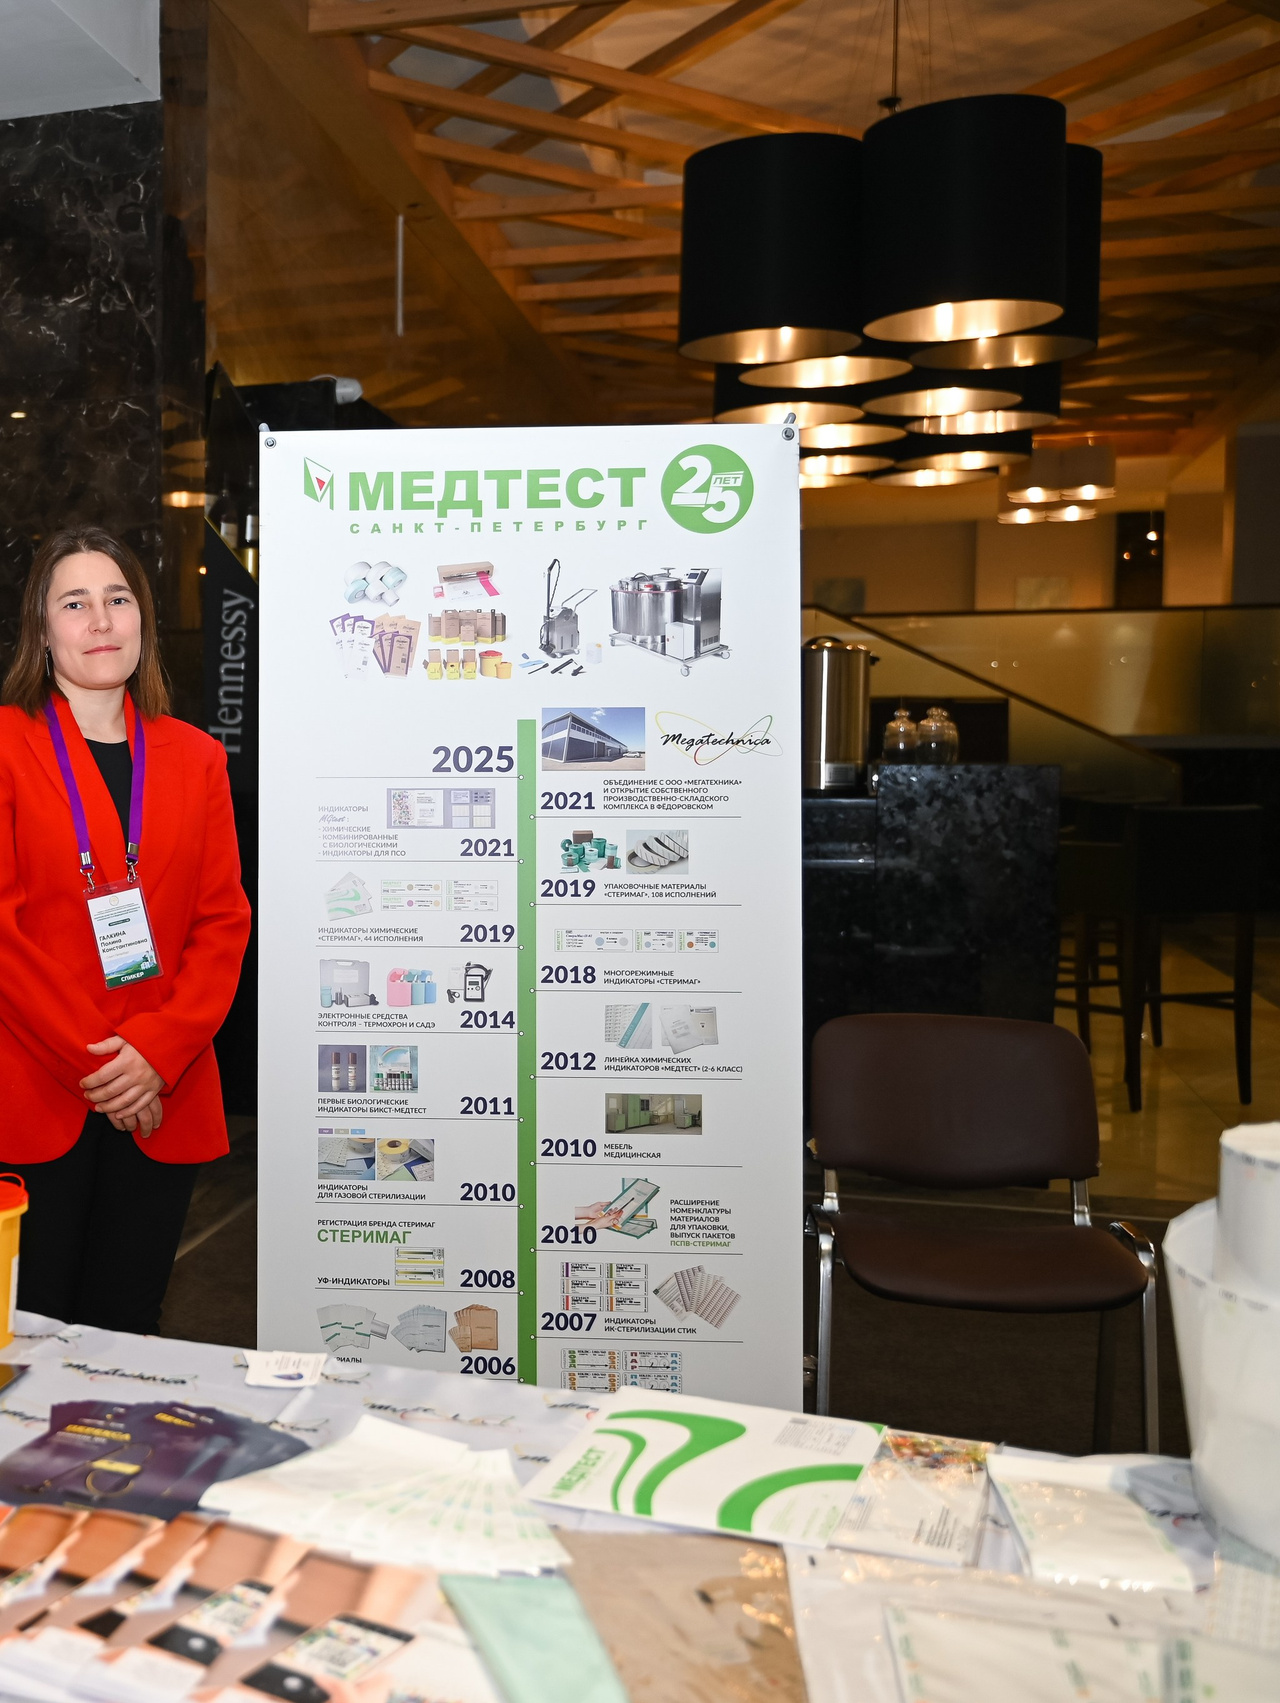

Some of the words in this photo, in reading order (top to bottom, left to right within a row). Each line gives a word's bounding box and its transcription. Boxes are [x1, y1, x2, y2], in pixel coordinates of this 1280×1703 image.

[713, 476, 741, 485] ЛЕТ
[348, 467, 646, 519] МЕДТЕСТ
[670, 454, 740, 524] 25
[349, 519, 649, 534] САНКТ-ПЕТЕРБУРГ
[208, 588, 254, 753] Hennessy
[660, 732, 771, 752] Megatechnica
[432, 745, 515, 773] 2025
[540, 791, 595, 810] 2021
[656, 802, 714, 811] ФЁДОРОВСКОМ
[460, 838, 515, 857] 2021
[322, 850, 373, 858] ИНДИКАТОРЫ
[373, 850, 390, 858] ДЛЯ
[540, 879, 596, 898] 2019
[604, 891, 650, 899] «СТЕРИМАГ»,
[664, 890, 717, 898] ИСПОЛНЕНИЙ
[99, 930, 126, 942] ГАЛКИНА
[318, 927, 368, 935] ИНДИКАТОРЫ
[460, 924, 515, 943] 2019
[120, 972, 145, 982] СПИКЕР
[540, 965, 596, 984] 2018
[603, 978, 655, 986] ИНДИКАТОРЫ
[318, 1012, 371, 1020] ЭЛЕКТРОННЫЕ
[460, 1010, 515, 1029] 2014
[318, 1020, 357, 1028] КОНТРОЛЯ
[415, 1021, 436, 1029] САДЭ
[540, 1052, 596, 1070] 2012
[604, 1055, 640, 1064] ЛИНЕЙКА
[604, 1065, 660, 1073] ИНДИКАТОРОВ
[661, 1065, 701, 1073] «МЕДТЕСТ»
[701, 1065, 715, 1073] (2-6
[716, 1065, 743, 1073] КЛАСС)
[347, 1098, 409, 1106] БИОЛОГИЧЕСКИЕ
[460, 1096, 515, 1116] 2011
[318, 1106, 368, 1115] ИНДИКАТОРЫ
[369, 1107, 427, 1115] БИКСТ-МЕДТЕСТ
[540, 1138, 597, 1157] 2010
[603, 1151, 661, 1159] МЕДИЦИНСКАЯ
[317, 1184, 368, 1192] ИНДИКАТОРЫ
[460, 1182, 516, 1202] 2010
[317, 1192, 333, 1200] ДЛЯ
[334, 1191, 368, 1199] ГАЗОВОЙ
[368, 1192, 426, 1201] СТЕРИЛИЗАЦИИ
[670, 1207, 732, 1215] НОМЕНКЛАТУРЫ
[317, 1219, 367, 1227] РЕГИСТРАЦИЯ
[369, 1220, 397, 1228] БРЕНДА
[670, 1224, 686, 1232] ДЛЯ
[687, 1224, 729, 1232] УПАКОВКИ,
[317, 1229, 412, 1244] СТЕРИМАГ
[541, 1225, 597, 1244] 2010
[702, 1232, 736, 1240] ПАКЕТОВ
[670, 1240, 732, 1248] ПСПВ-СТЕРИМАГ
[317, 1277, 390, 1287] УФ-ИНДИКАТОРЫ
[460, 1269, 516, 1288] 2008
[541, 1312, 597, 1332] 2007
[604, 1317, 656, 1325] ИНДИКАТОРЫ
[604, 1325, 676, 1334] ИК-СТЕРИЛИЗАЦИИ
[460, 1356, 516, 1375] 2006
